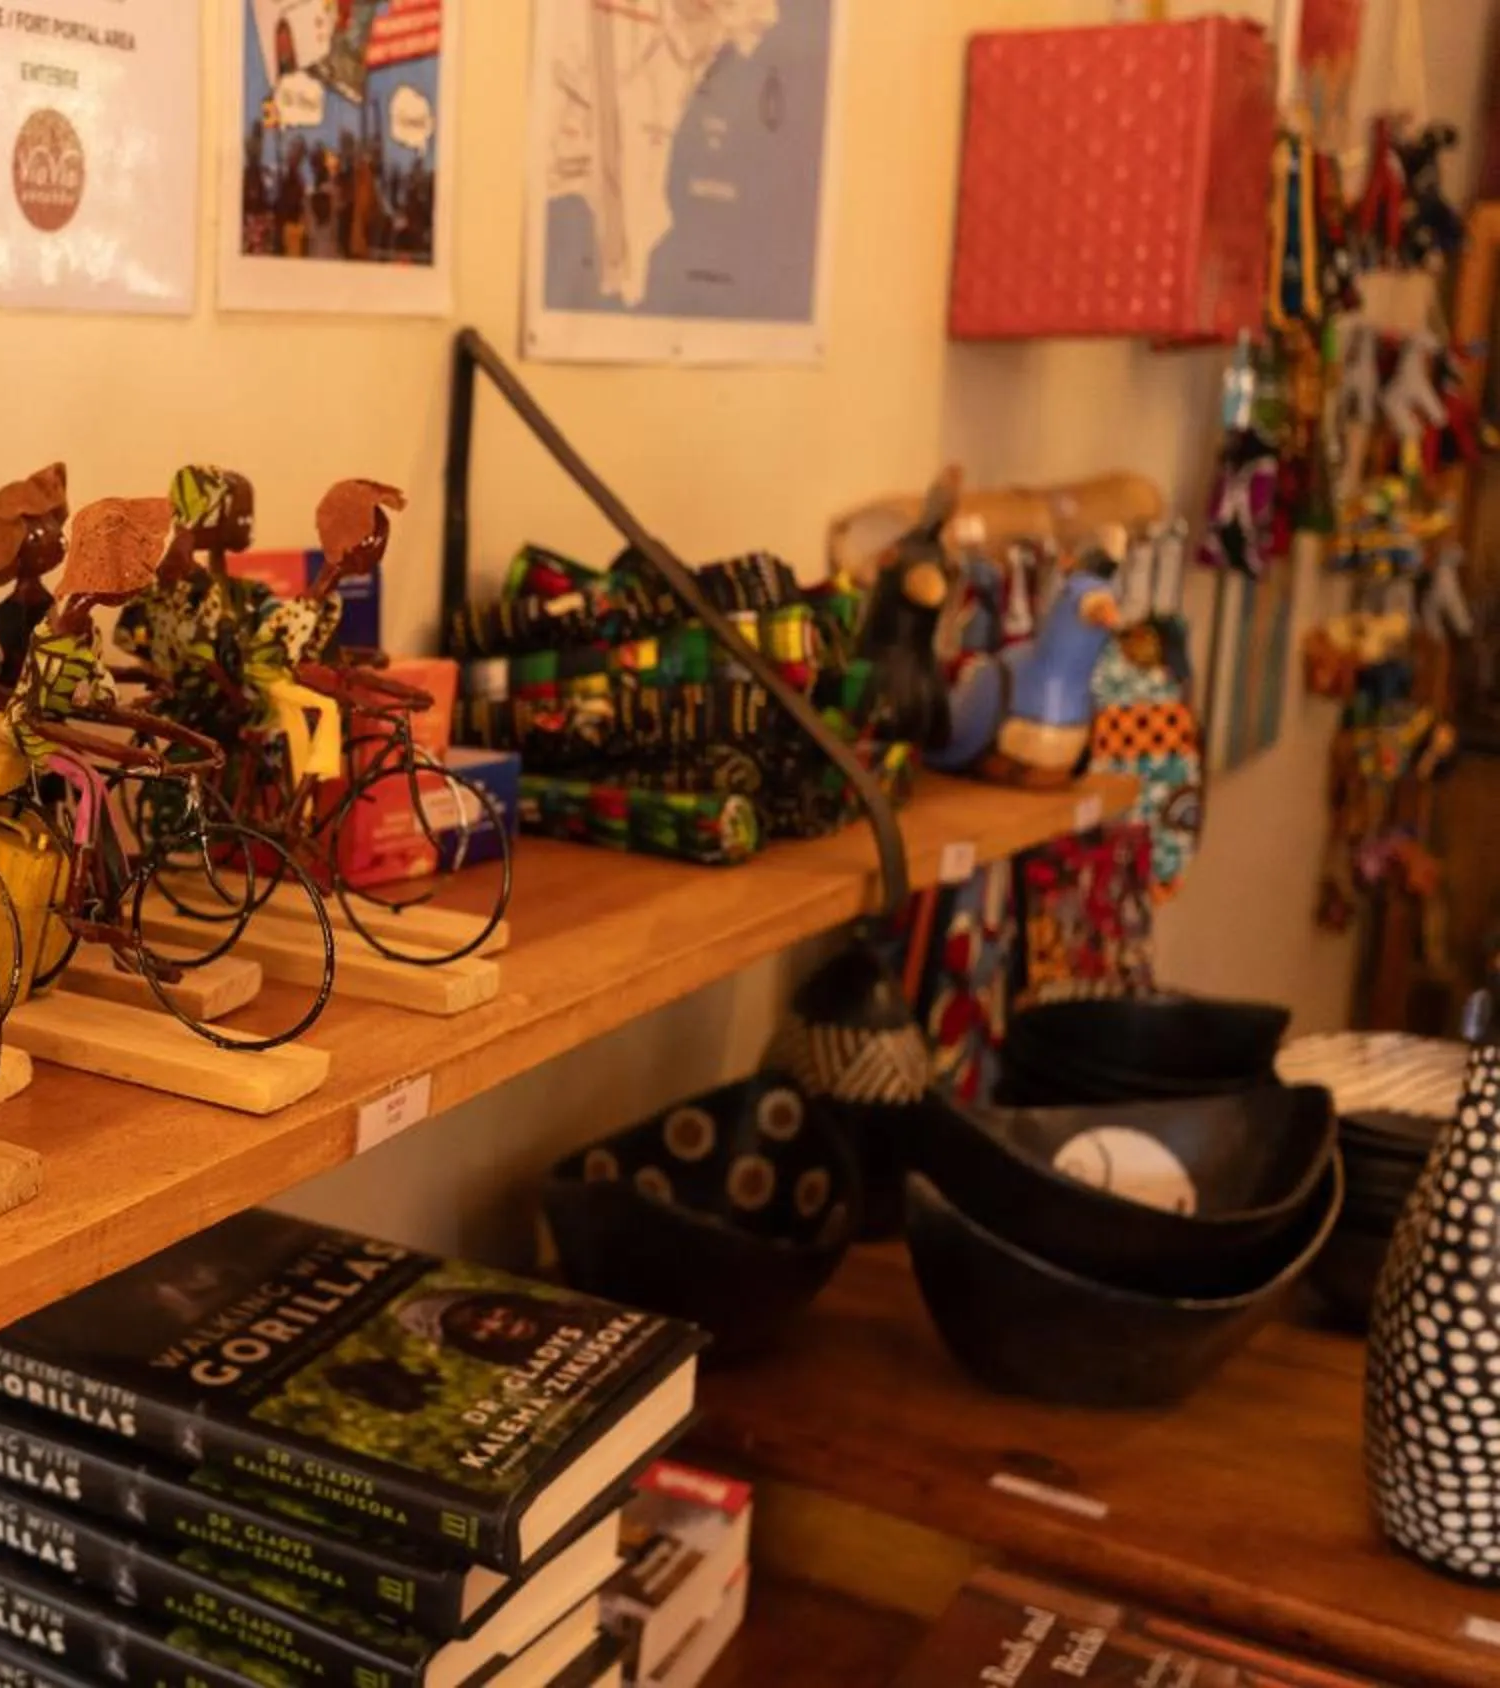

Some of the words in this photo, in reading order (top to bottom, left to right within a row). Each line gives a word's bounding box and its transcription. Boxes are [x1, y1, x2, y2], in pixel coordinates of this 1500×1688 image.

[16, 11, 49, 35] FORT
[53, 18, 102, 45] PORTAL
[149, 1281, 290, 1369] WALKING
[190, 1242, 407, 1386] GORILLAS
[504, 1326, 583, 1391] GLADYS
[83, 1376, 137, 1409] WITH
[459, 1312, 646, 1470] KALEMA-ZIKUSOKA
[27, 1443, 81, 1474] WITH
[303, 1460, 375, 1496] GLADYS
[26, 1511, 76, 1545] WITH
